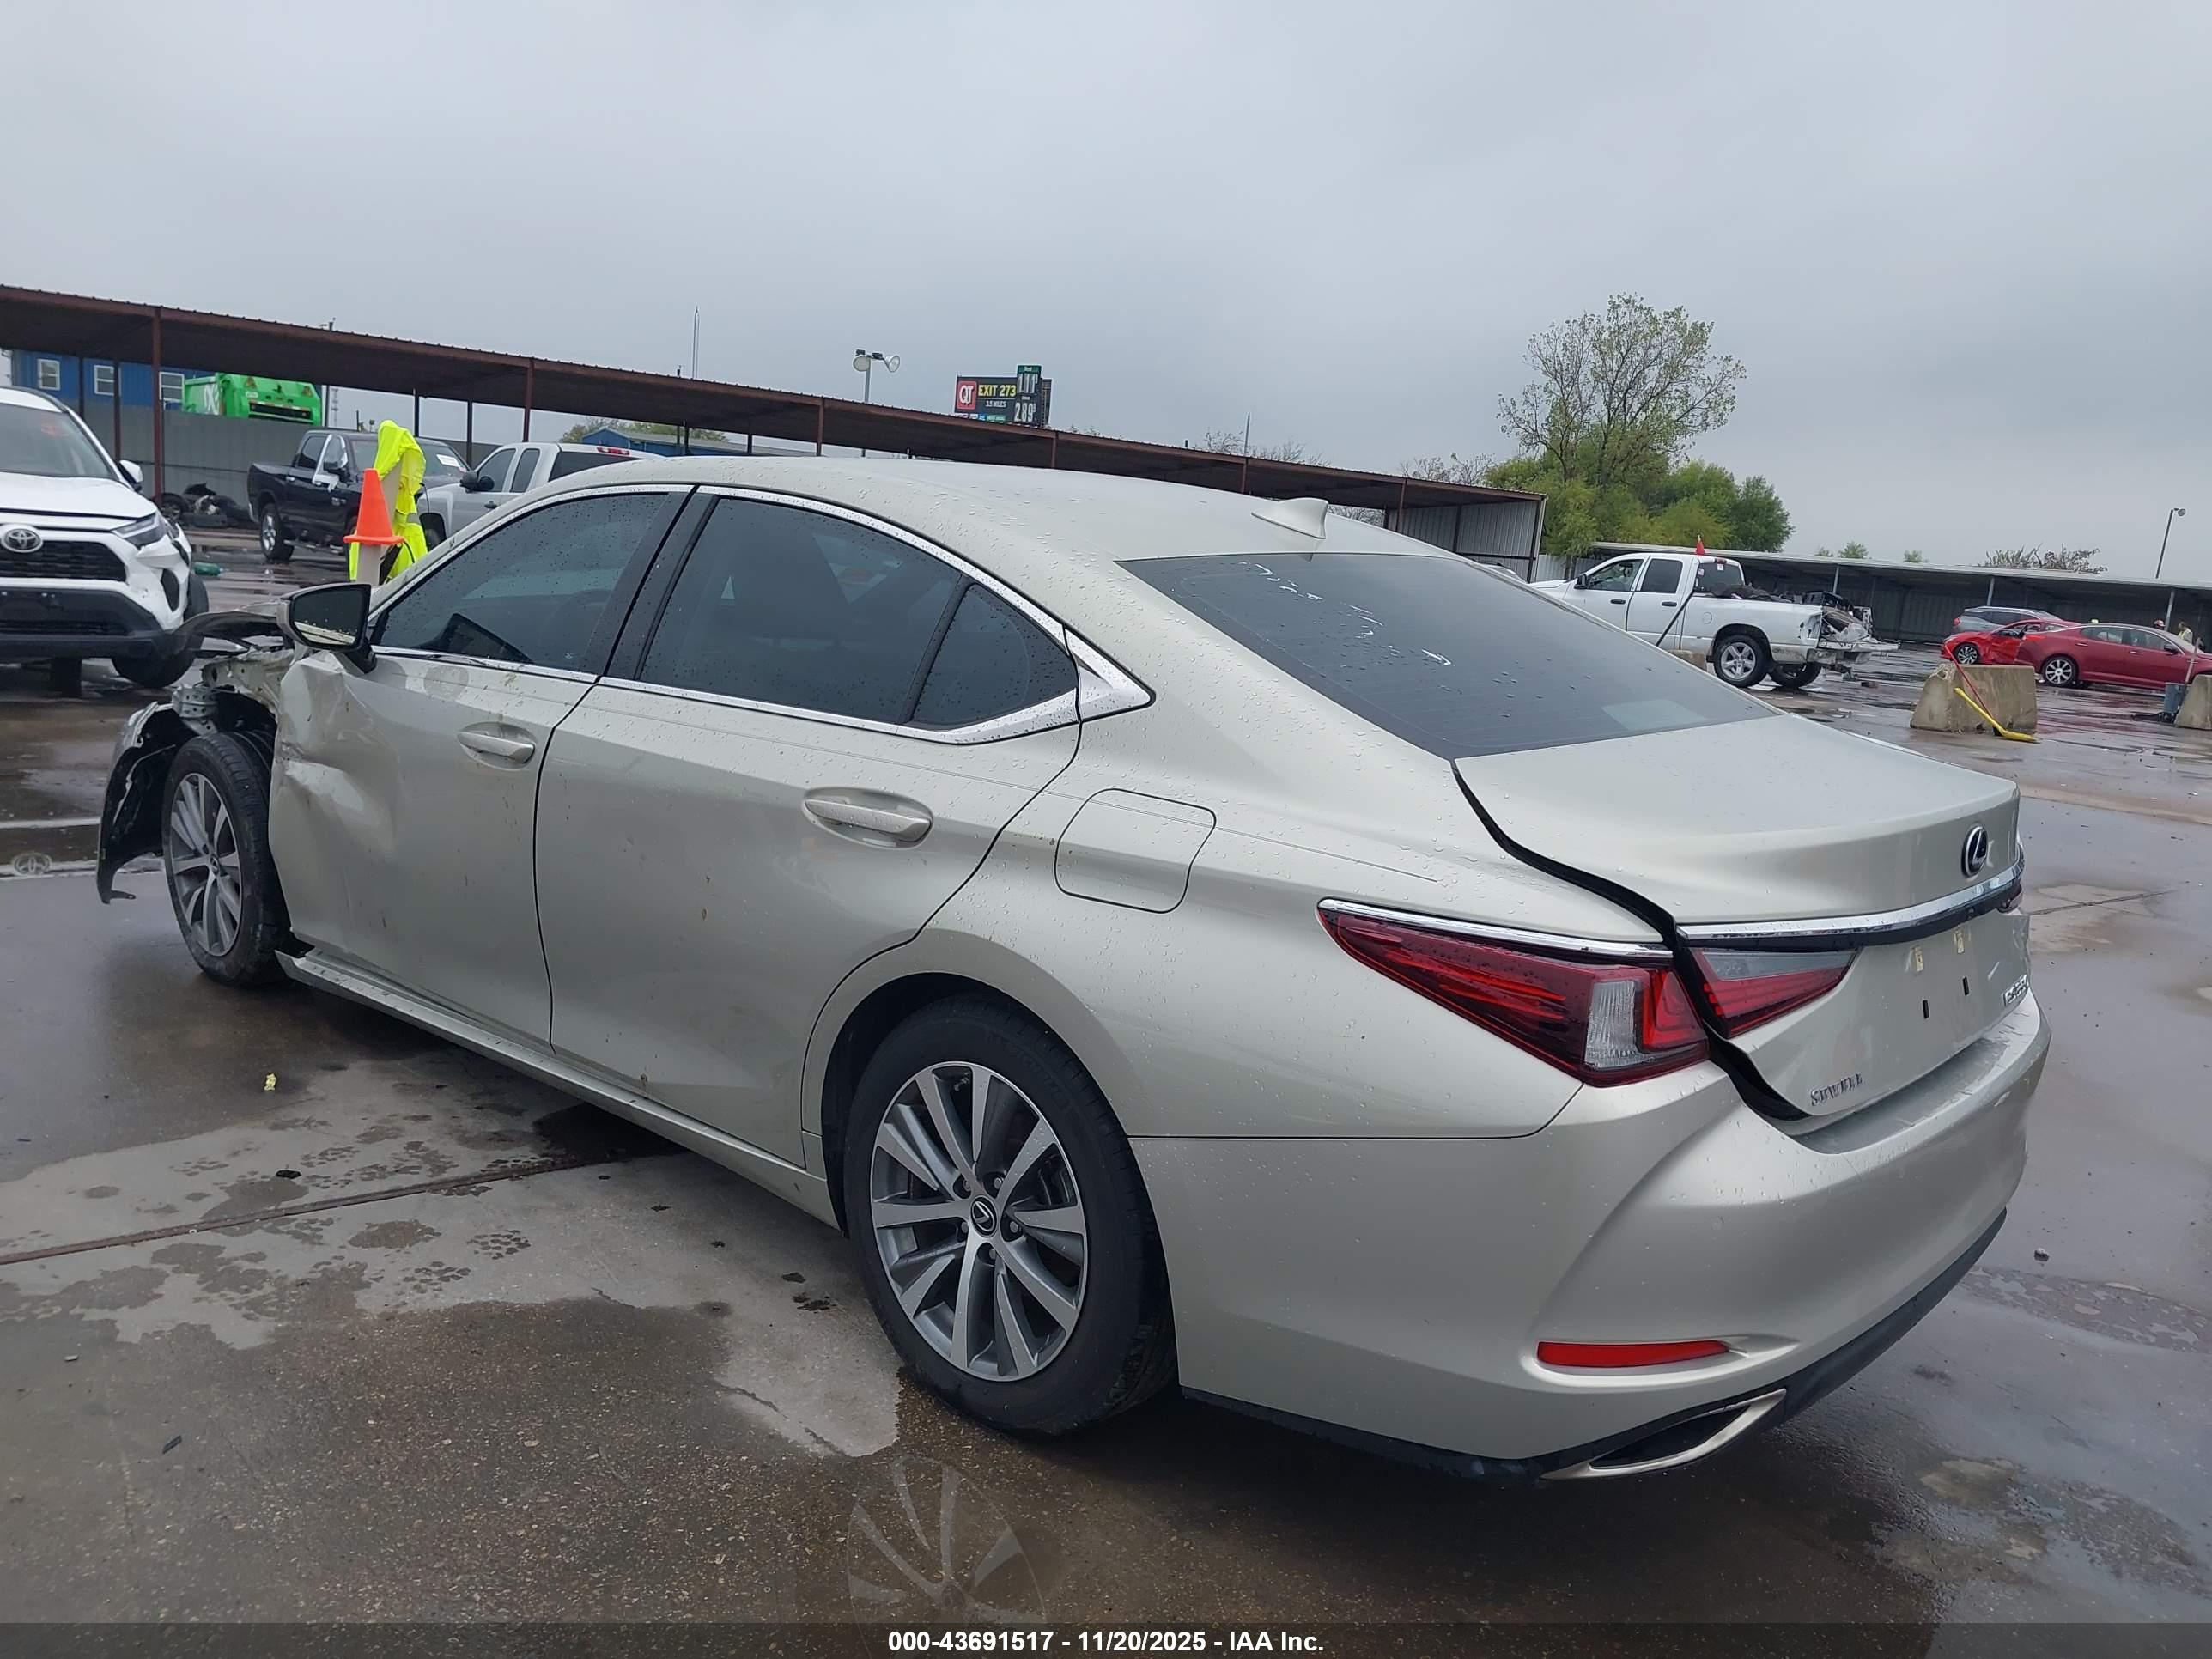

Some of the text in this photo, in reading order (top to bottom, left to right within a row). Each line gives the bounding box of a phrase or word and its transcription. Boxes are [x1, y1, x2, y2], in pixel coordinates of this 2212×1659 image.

[959, 385, 974, 404] QT
[978, 384, 1017, 397] EXIT 273
[1014, 402, 1033, 422] 289
